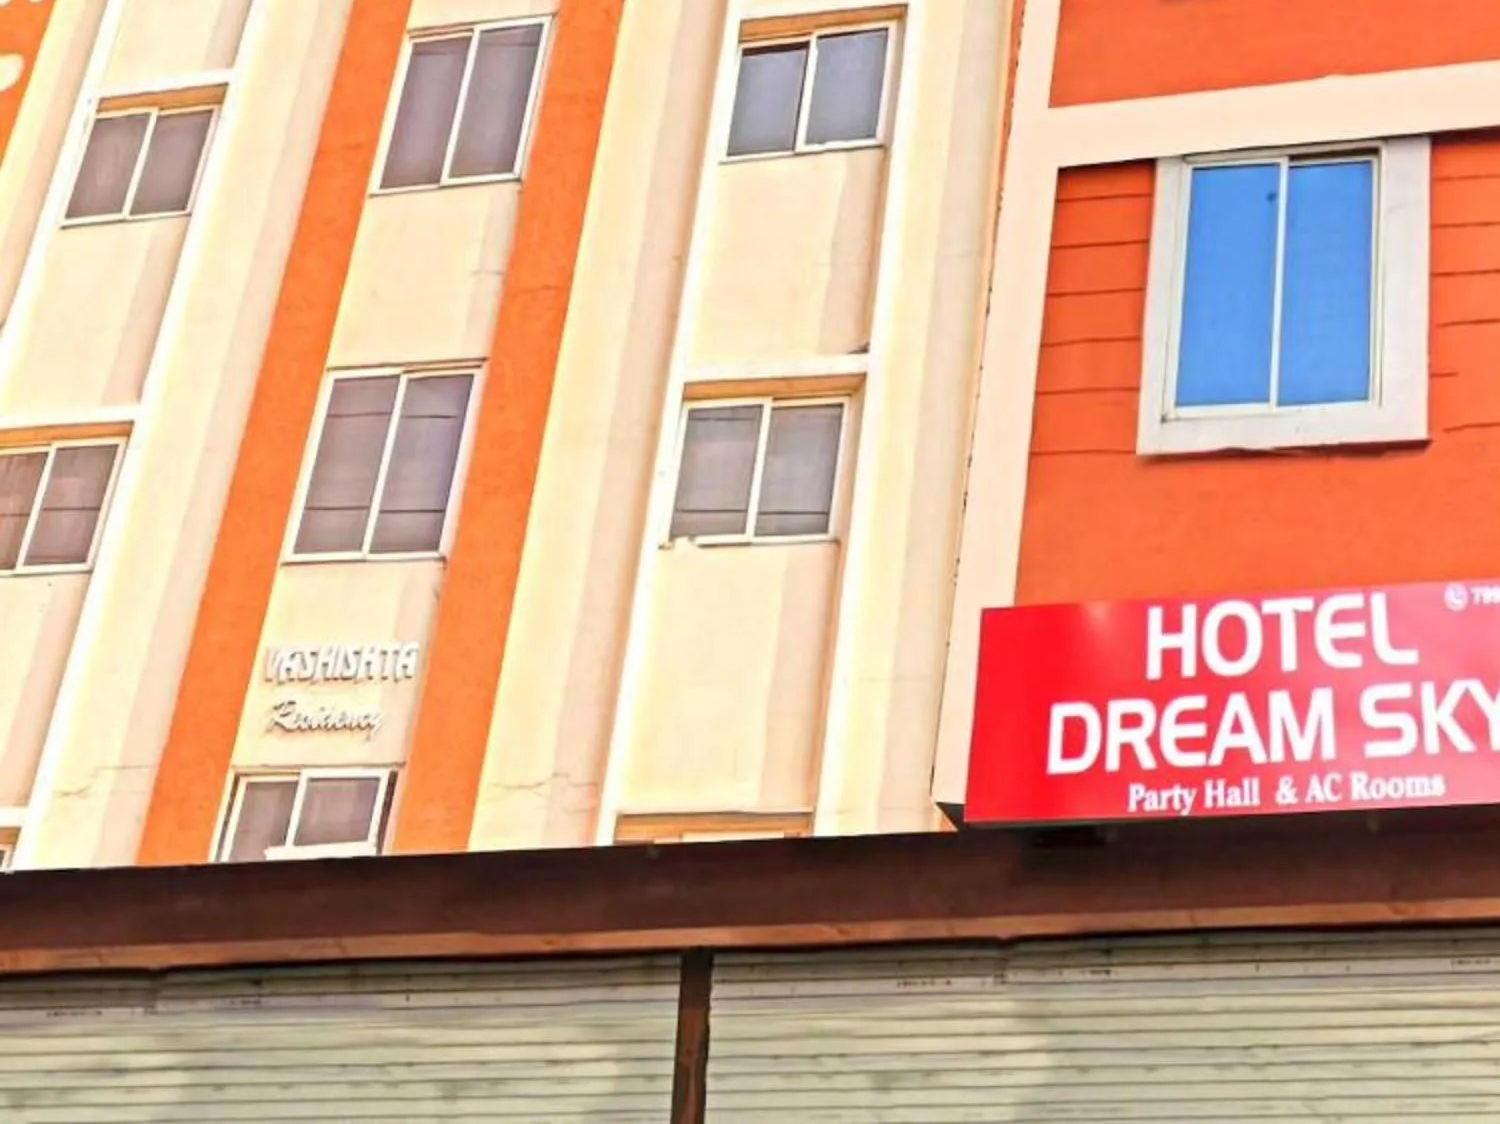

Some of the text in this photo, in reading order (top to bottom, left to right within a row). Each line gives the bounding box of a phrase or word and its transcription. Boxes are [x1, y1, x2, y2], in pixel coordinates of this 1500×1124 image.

[1146, 592, 1419, 680] HOTEL
[1047, 686, 1336, 775] DREAM
[1128, 770, 1446, 816] Party Hall & AC Rooms
